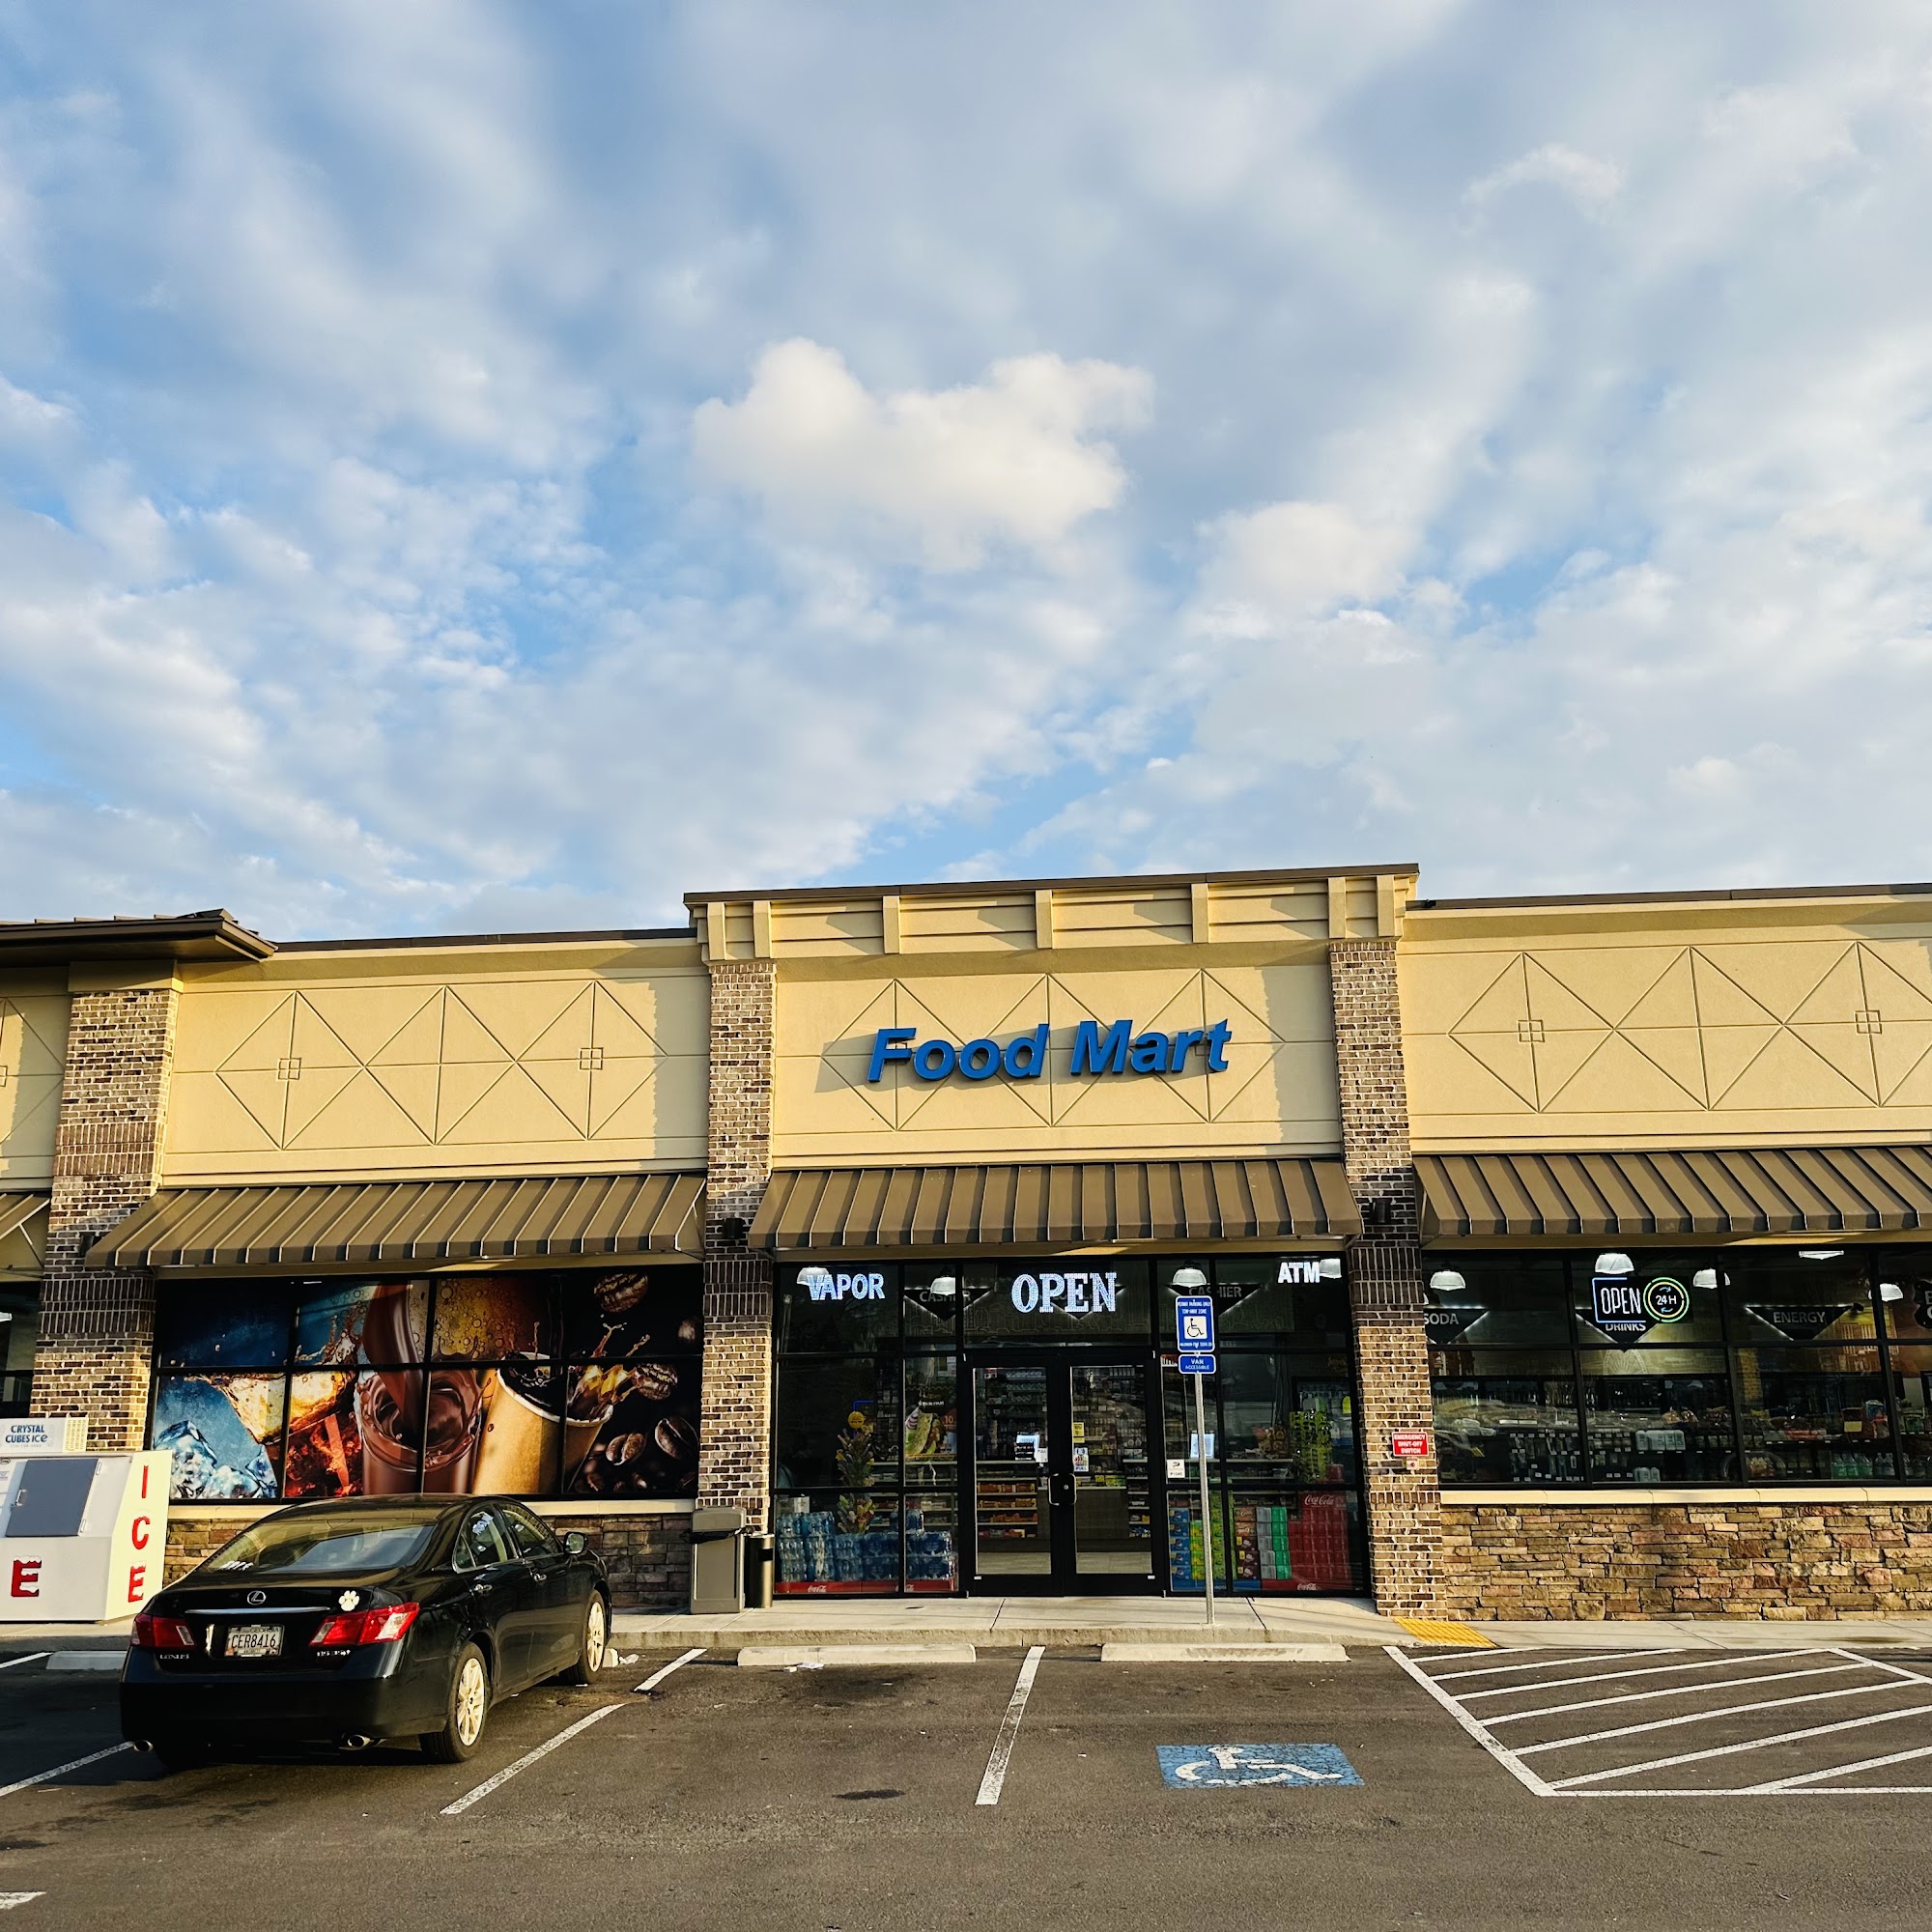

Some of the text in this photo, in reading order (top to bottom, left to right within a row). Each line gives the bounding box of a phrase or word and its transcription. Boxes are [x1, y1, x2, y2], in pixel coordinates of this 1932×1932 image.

[867, 1018, 1233, 1083] Food Mart
[1277, 1262, 1321, 1284] ATM
[807, 1272, 887, 1301] VAPOR
[1011, 1272, 1118, 1314] OPEN
[1600, 1287, 1642, 1316] OPEN
[1423, 1313, 1460, 1325] SODA
[1773, 1311, 1826, 1323] ENERGY
[11, 1424, 45, 1434] CRYSTAL
[5, 1435, 32, 1443] CUBES
[231, 1634, 276, 1648] CER8416
